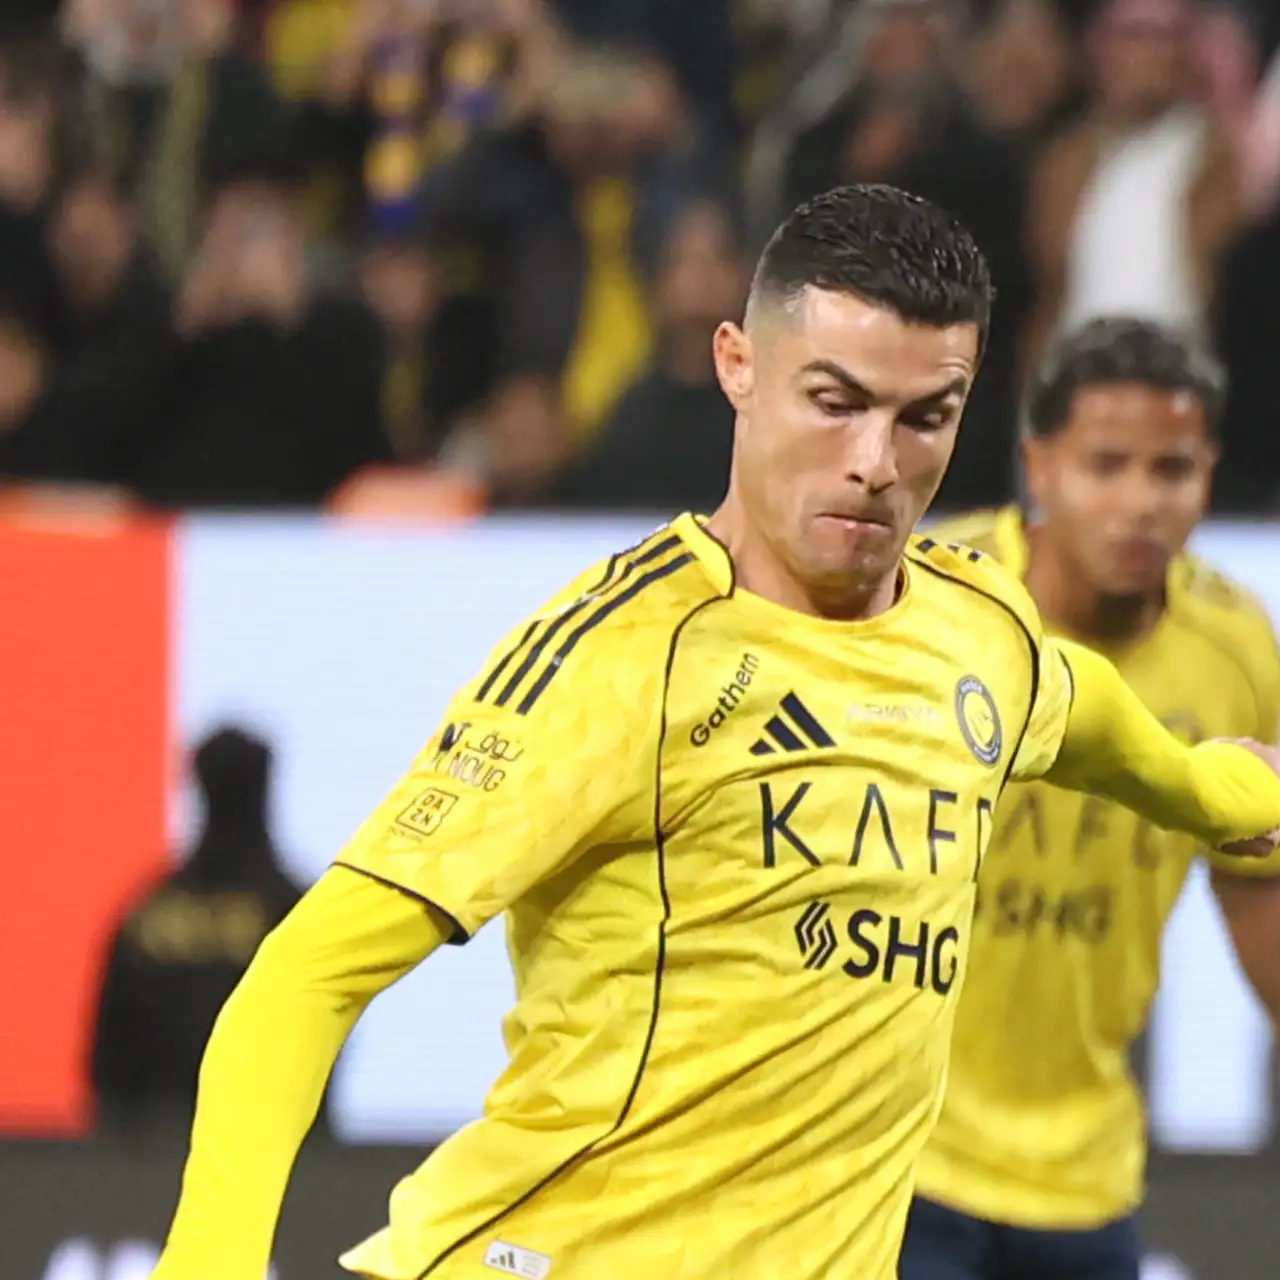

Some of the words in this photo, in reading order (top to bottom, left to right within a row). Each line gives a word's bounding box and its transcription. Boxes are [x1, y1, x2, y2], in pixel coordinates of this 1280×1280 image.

[689, 652, 760, 748] Gathern
[447, 751, 506, 793] NOUG
[842, 908, 960, 997] SHG
